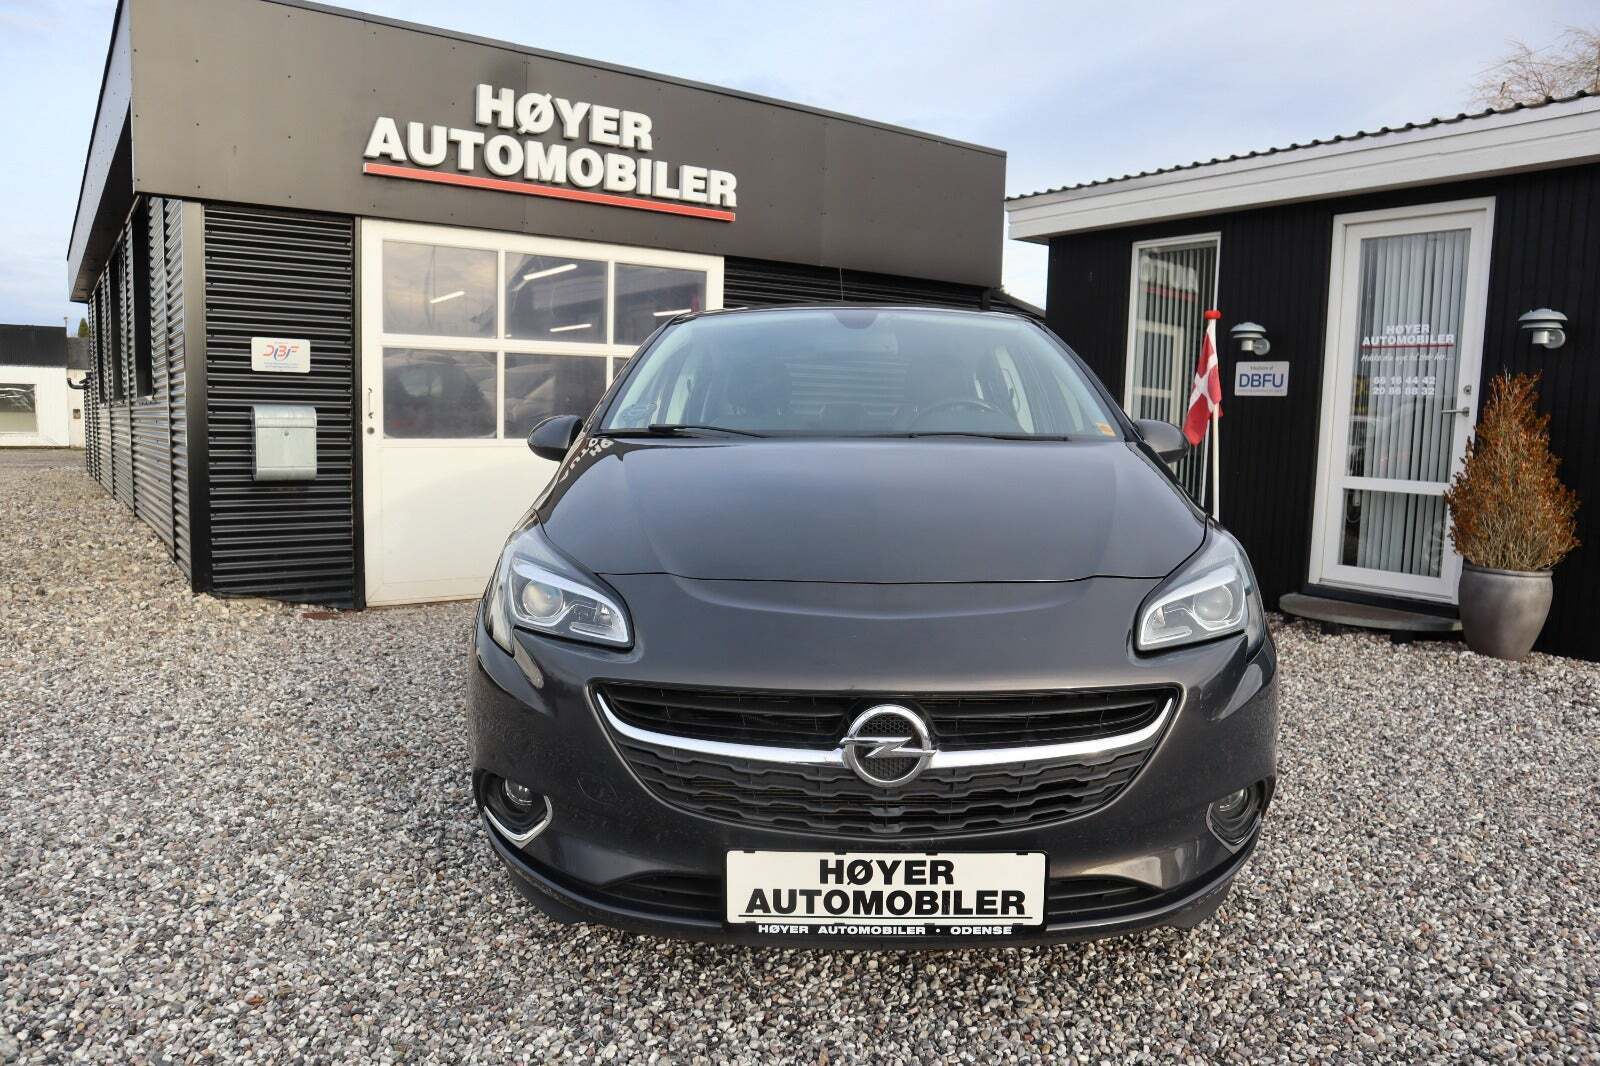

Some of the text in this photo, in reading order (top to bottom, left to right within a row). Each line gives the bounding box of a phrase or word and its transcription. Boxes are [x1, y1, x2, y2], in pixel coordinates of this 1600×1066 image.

[476, 84, 654, 151] HØYER
[363, 116, 738, 208] AUTOMOBILER
[1386, 323, 1430, 334] HØYER
[1362, 334, 1455, 346] AUTOMOBILER
[1239, 373, 1284, 388] DBFU
[819, 858, 954, 885] HØYER
[745, 888, 1026, 915] AUTOMOBILER
[758, 924, 1013, 936] HØYER AUTOMOBILER ODENSE
